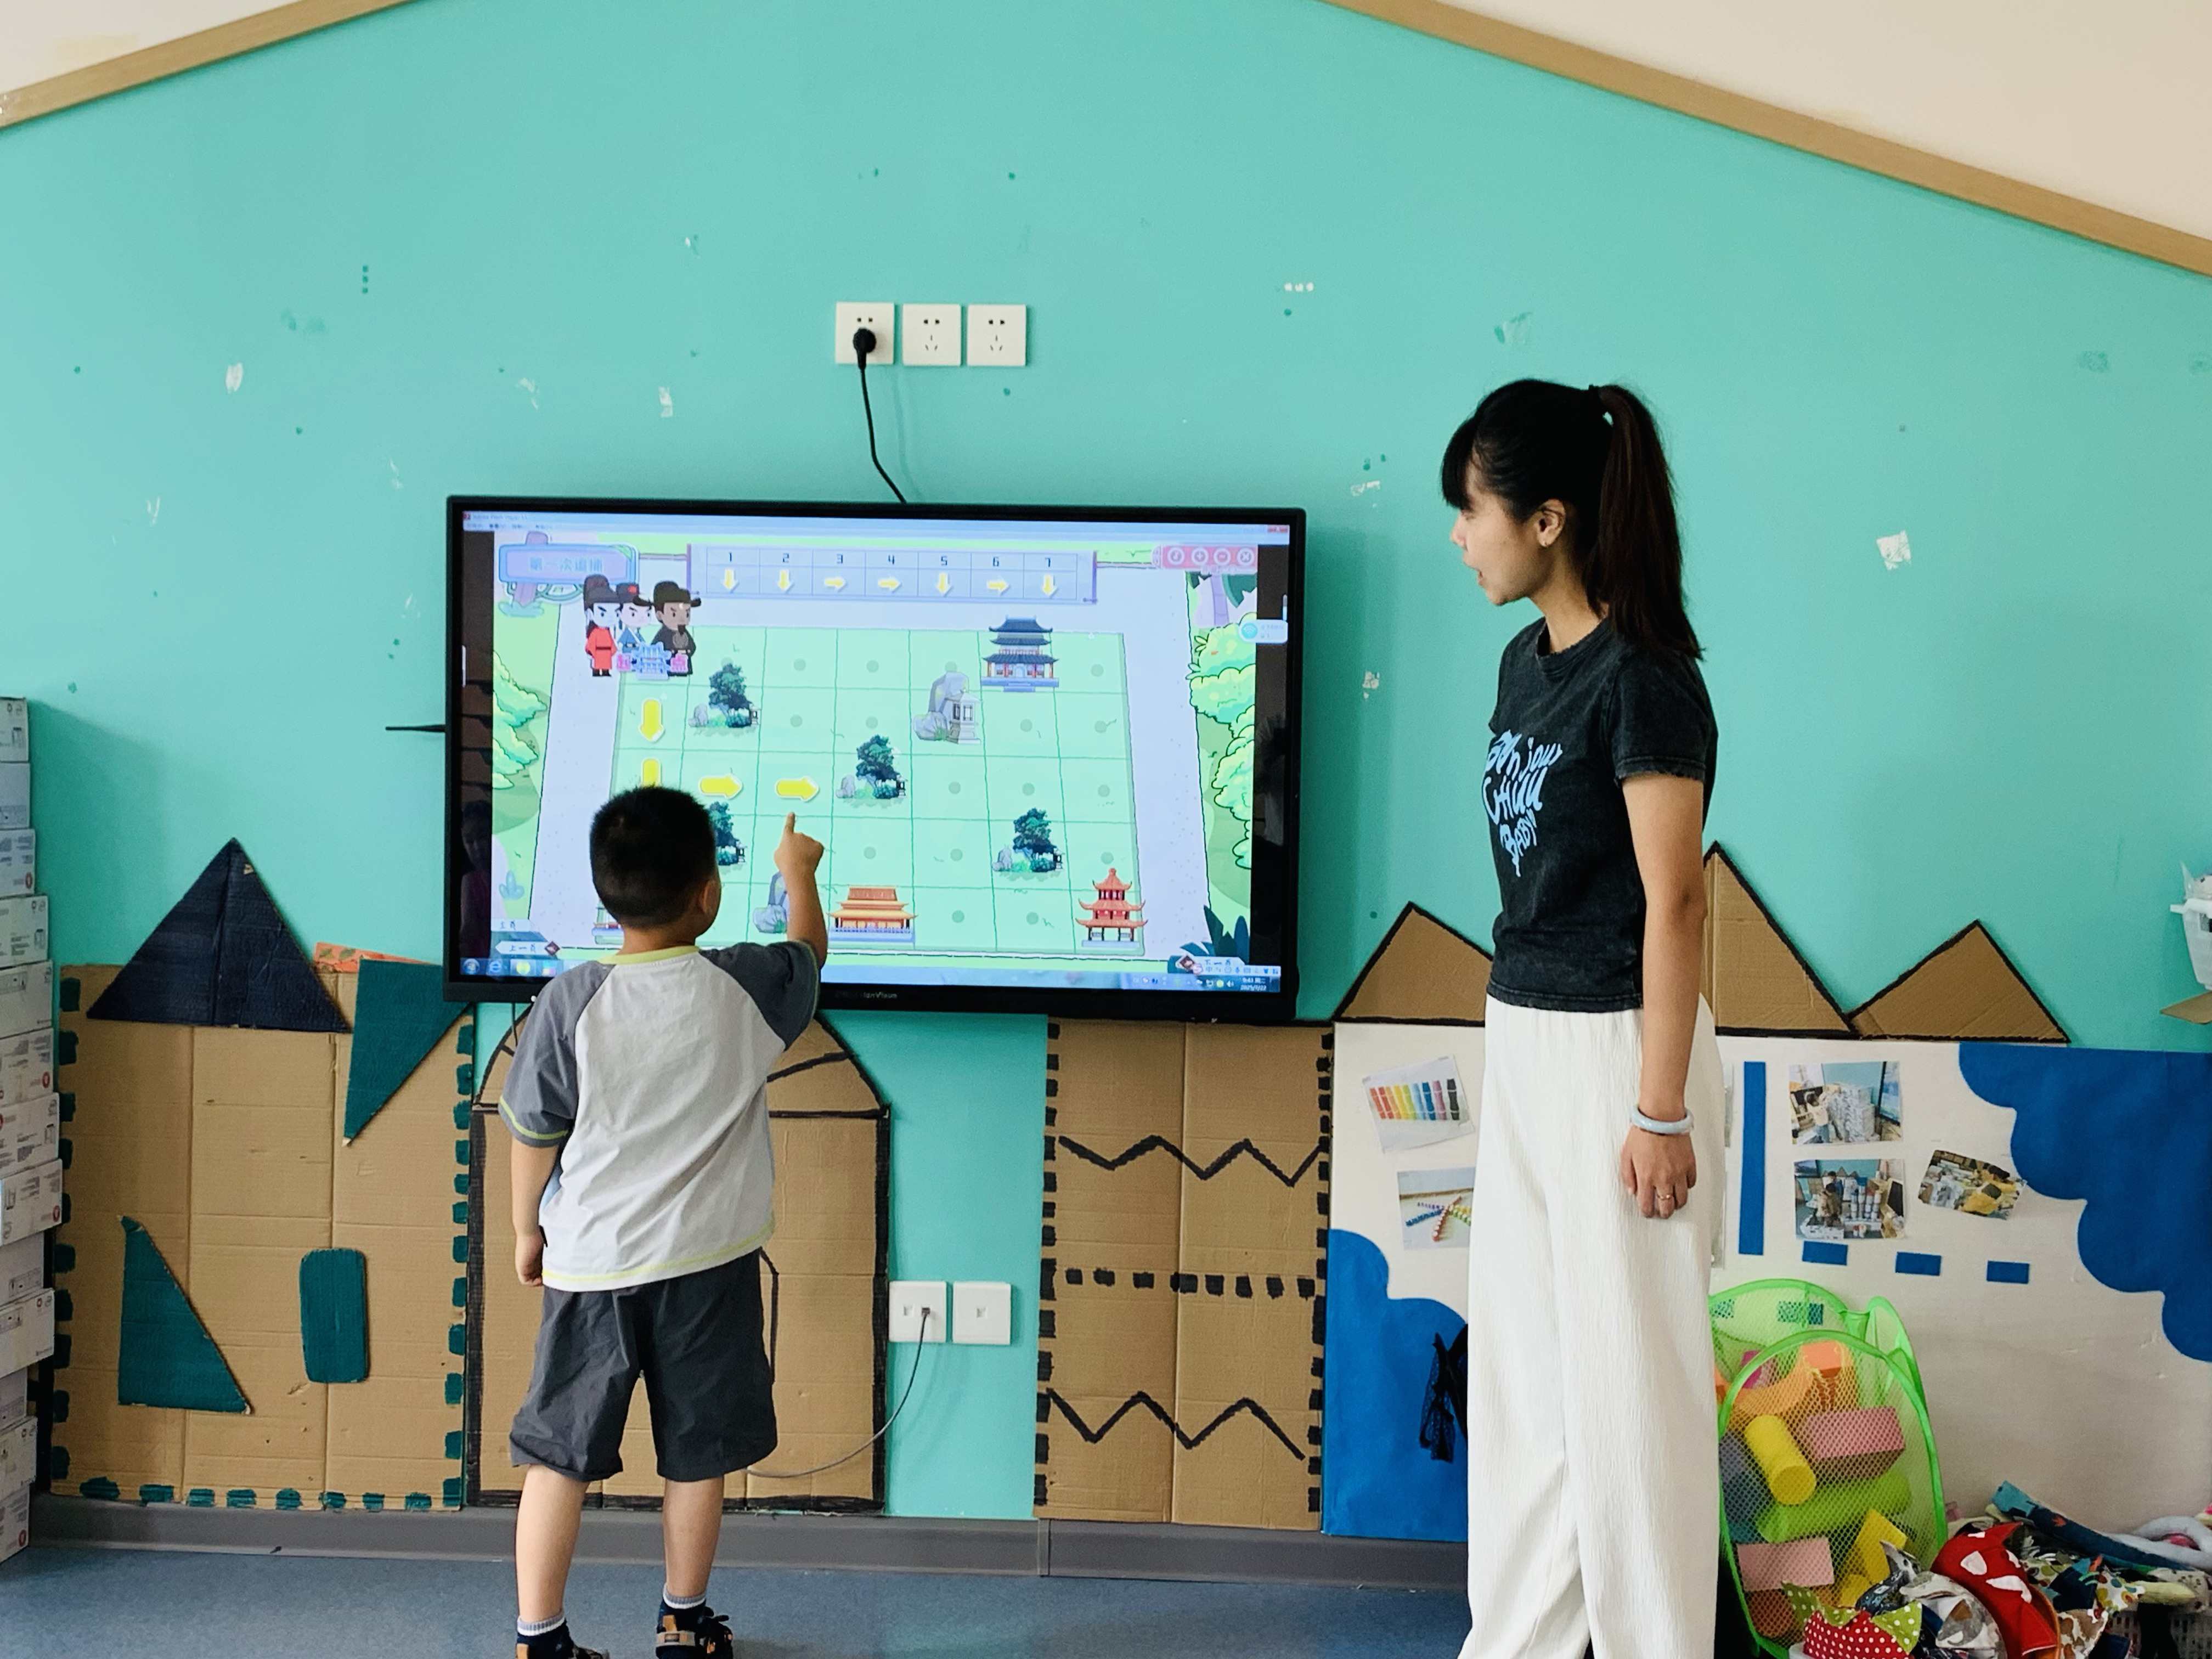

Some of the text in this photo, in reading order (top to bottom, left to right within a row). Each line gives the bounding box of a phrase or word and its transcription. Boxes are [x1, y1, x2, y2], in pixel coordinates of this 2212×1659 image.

[782, 553, 789, 563] 2
[836, 554, 844, 564] 3
[888, 556, 895, 565] 4
[940, 556, 948, 566] 5
[992, 557, 1000, 567] 6
[1045, 557, 1051, 568] 7
[509, 944, 536, 953] 上一页
